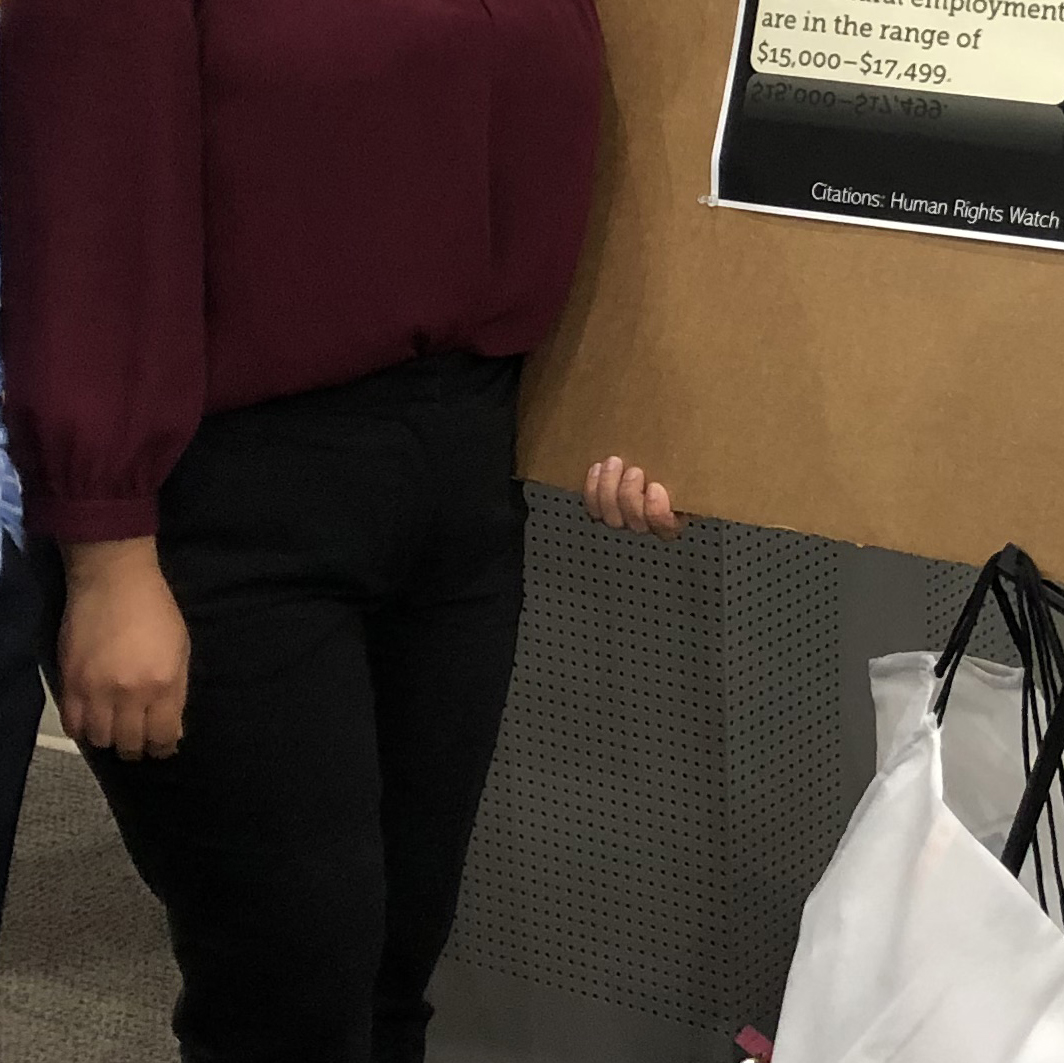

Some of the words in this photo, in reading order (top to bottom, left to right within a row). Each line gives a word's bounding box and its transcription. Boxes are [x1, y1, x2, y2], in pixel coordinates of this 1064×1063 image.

[761, 11, 797, 30] are
[802, 10, 826, 33] in
[833, 14, 873, 38] the
[879, 23, 950, 50] range
[956, 28, 982, 50] of
[811, 181, 885, 207] Citations:
[890, 191, 948, 215] Human
[953, 199, 1004, 224] Rights
[1009, 205, 1060, 229] Watch
